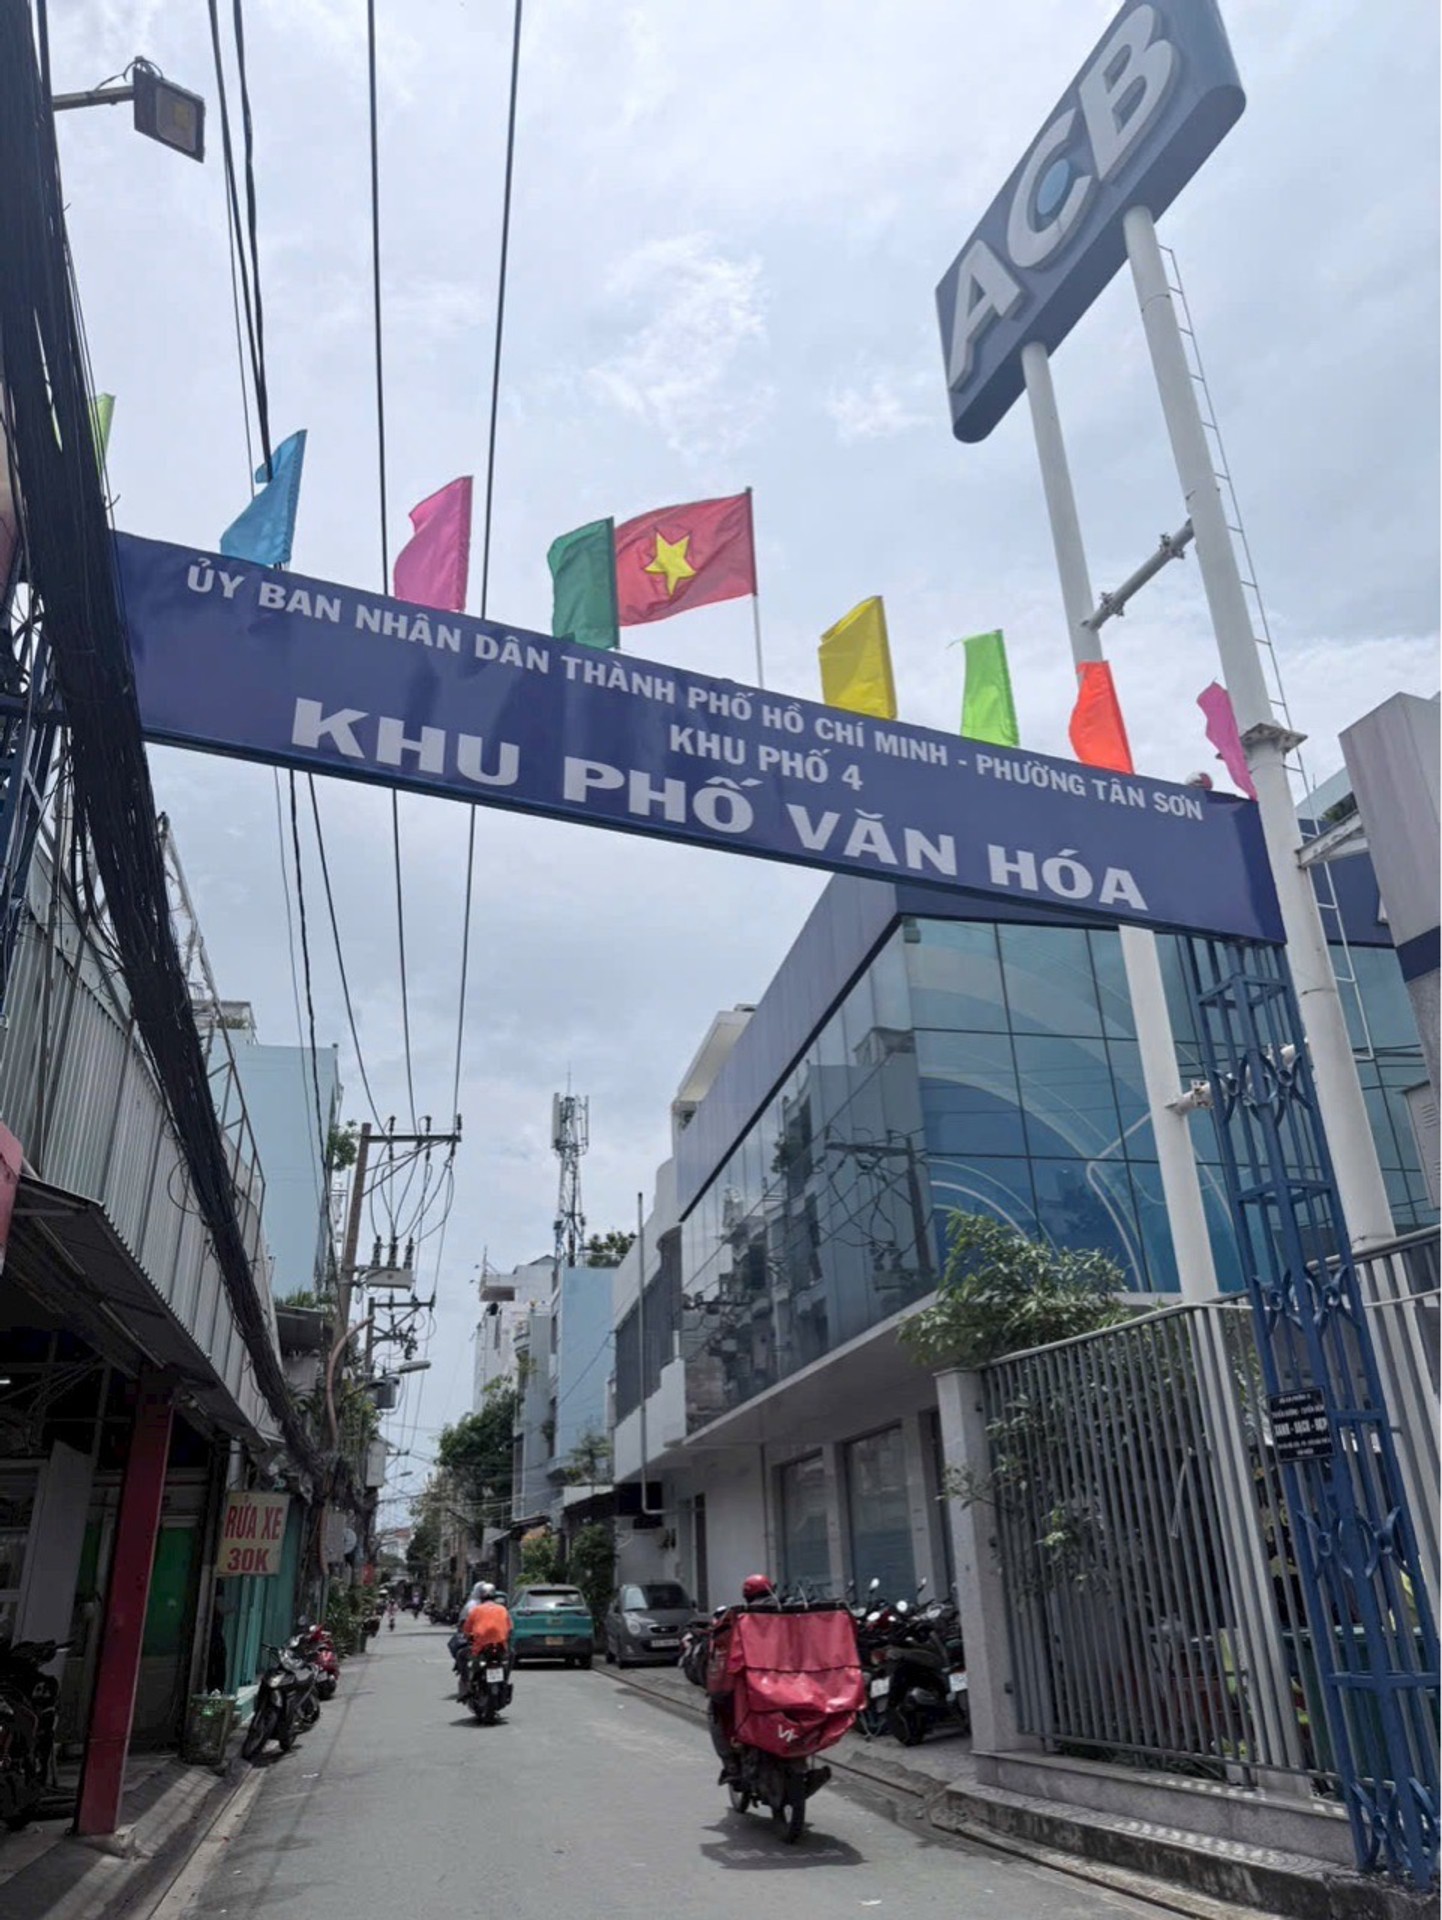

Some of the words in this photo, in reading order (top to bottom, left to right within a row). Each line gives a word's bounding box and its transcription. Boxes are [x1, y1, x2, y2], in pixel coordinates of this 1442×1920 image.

[949, 3, 1181, 393] ACB
[187, 557, 245, 599] ỦY
[258, 581, 342, 623] BAN
[355, 604, 462, 654] NHÂN
[474, 633, 550, 674] DÂN
[561, 655, 676, 704] THÀNH
[688, 686, 755, 721] PHỐ
[762, 701, 805, 734] HỒ
[814, 717, 866, 748] CHÍ
[874, 730, 948, 767] MINH
[975, 753, 1087, 797] PHƯỜNG
[1091, 777, 1147, 809] TÂN
[1152, 791, 1204, 821] SƠN
[669, 723, 746, 766] KHU
[758, 744, 832, 784] PHỐ
[841, 763, 864, 791] 4
[291, 697, 520, 786] KHU
[563, 756, 764, 834] PHỐ
[786, 804, 958, 876] VĂN
[987, 843, 1149, 911] HÓA
[227, 1547, 269, 1572] 30K
[260, 1506, 284, 1540] XE
